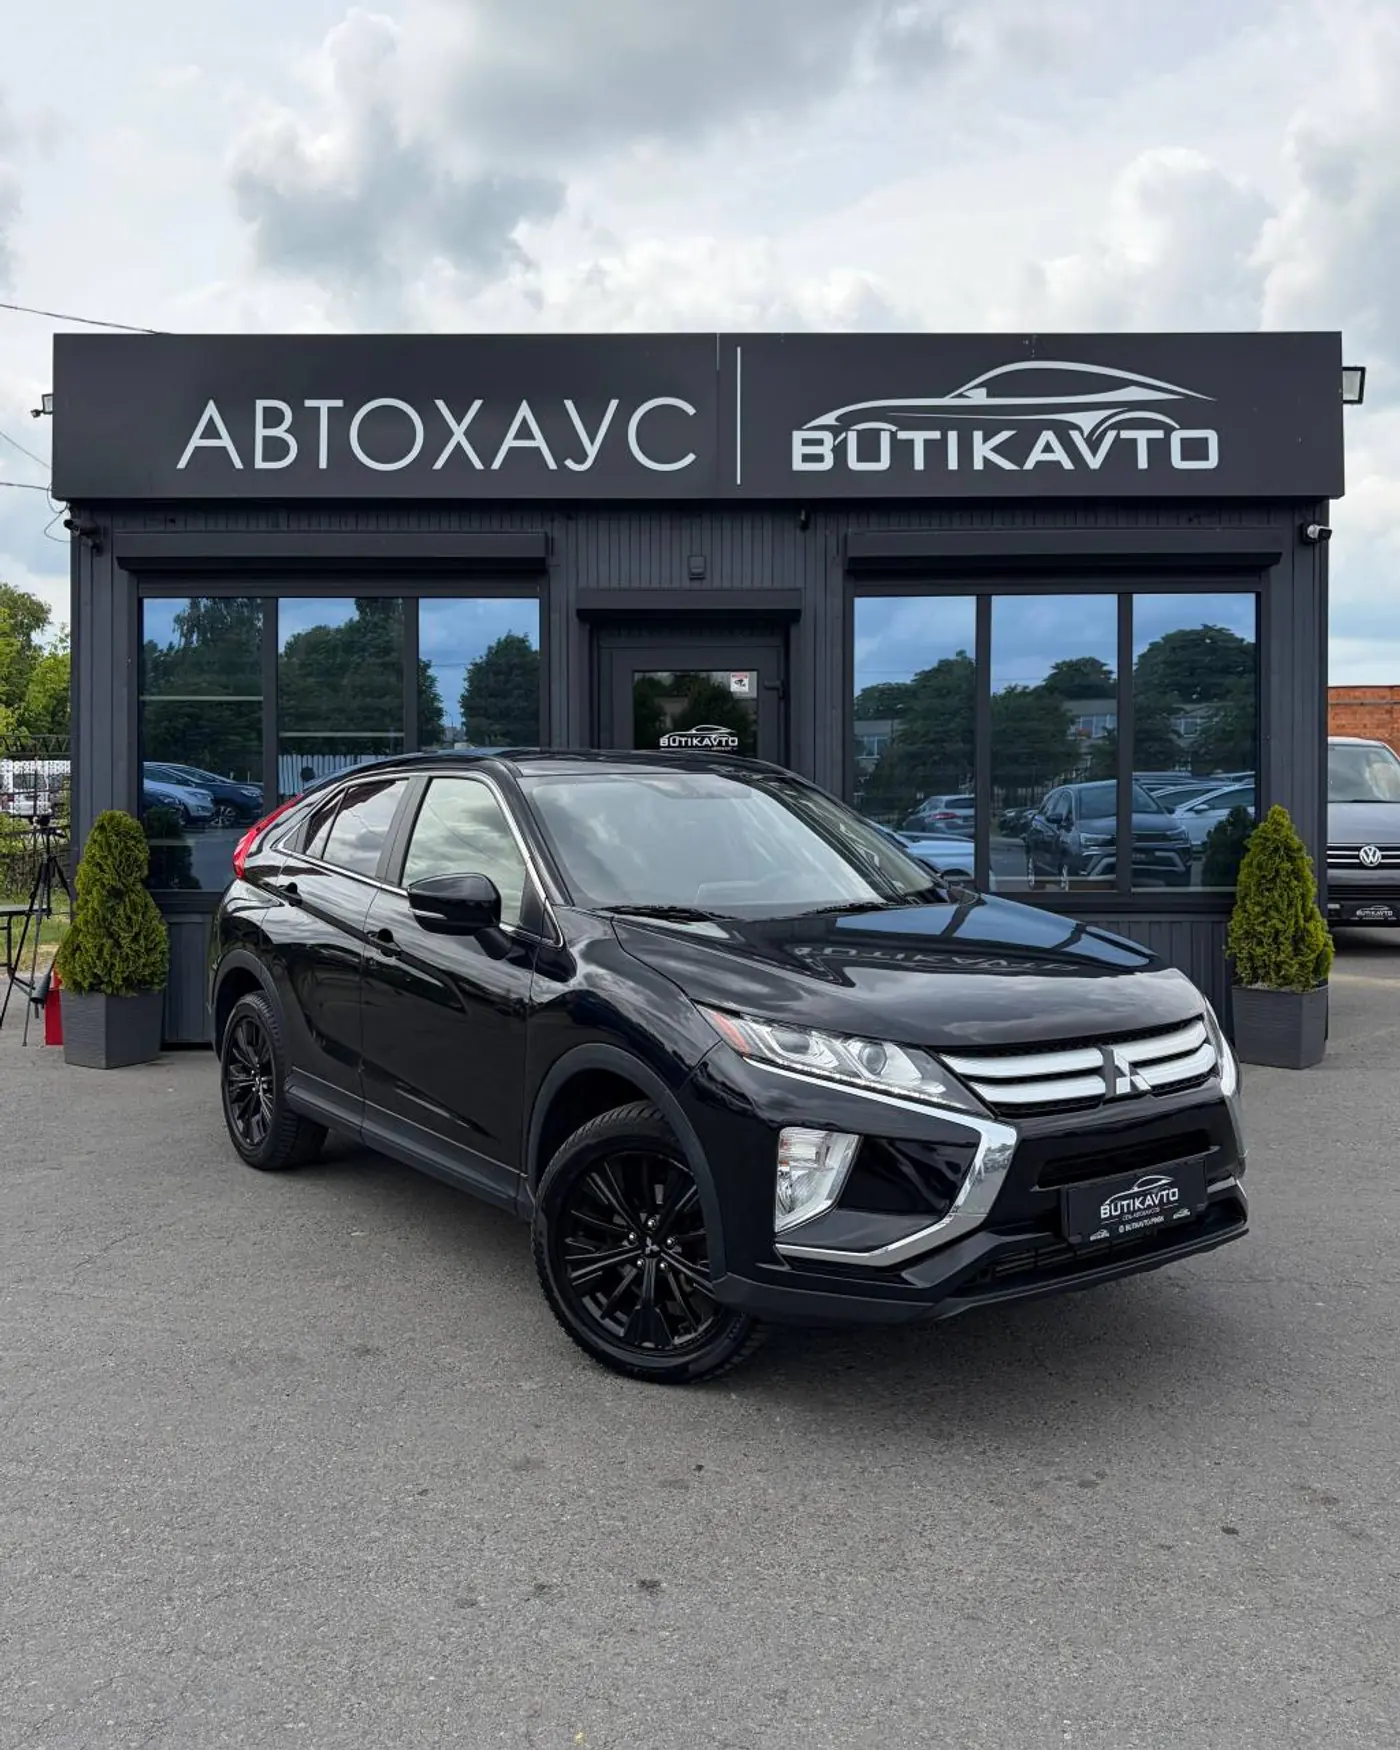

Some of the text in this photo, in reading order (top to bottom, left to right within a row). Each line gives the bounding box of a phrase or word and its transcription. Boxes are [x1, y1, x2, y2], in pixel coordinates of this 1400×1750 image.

[176, 397, 698, 473] АВТОХАУС
[791, 428, 1219, 472] BUTIKAVTO
[659, 736, 739, 747] BUTIKAVTO
[1100, 1188, 1179, 1219] BUTIKAVTO
